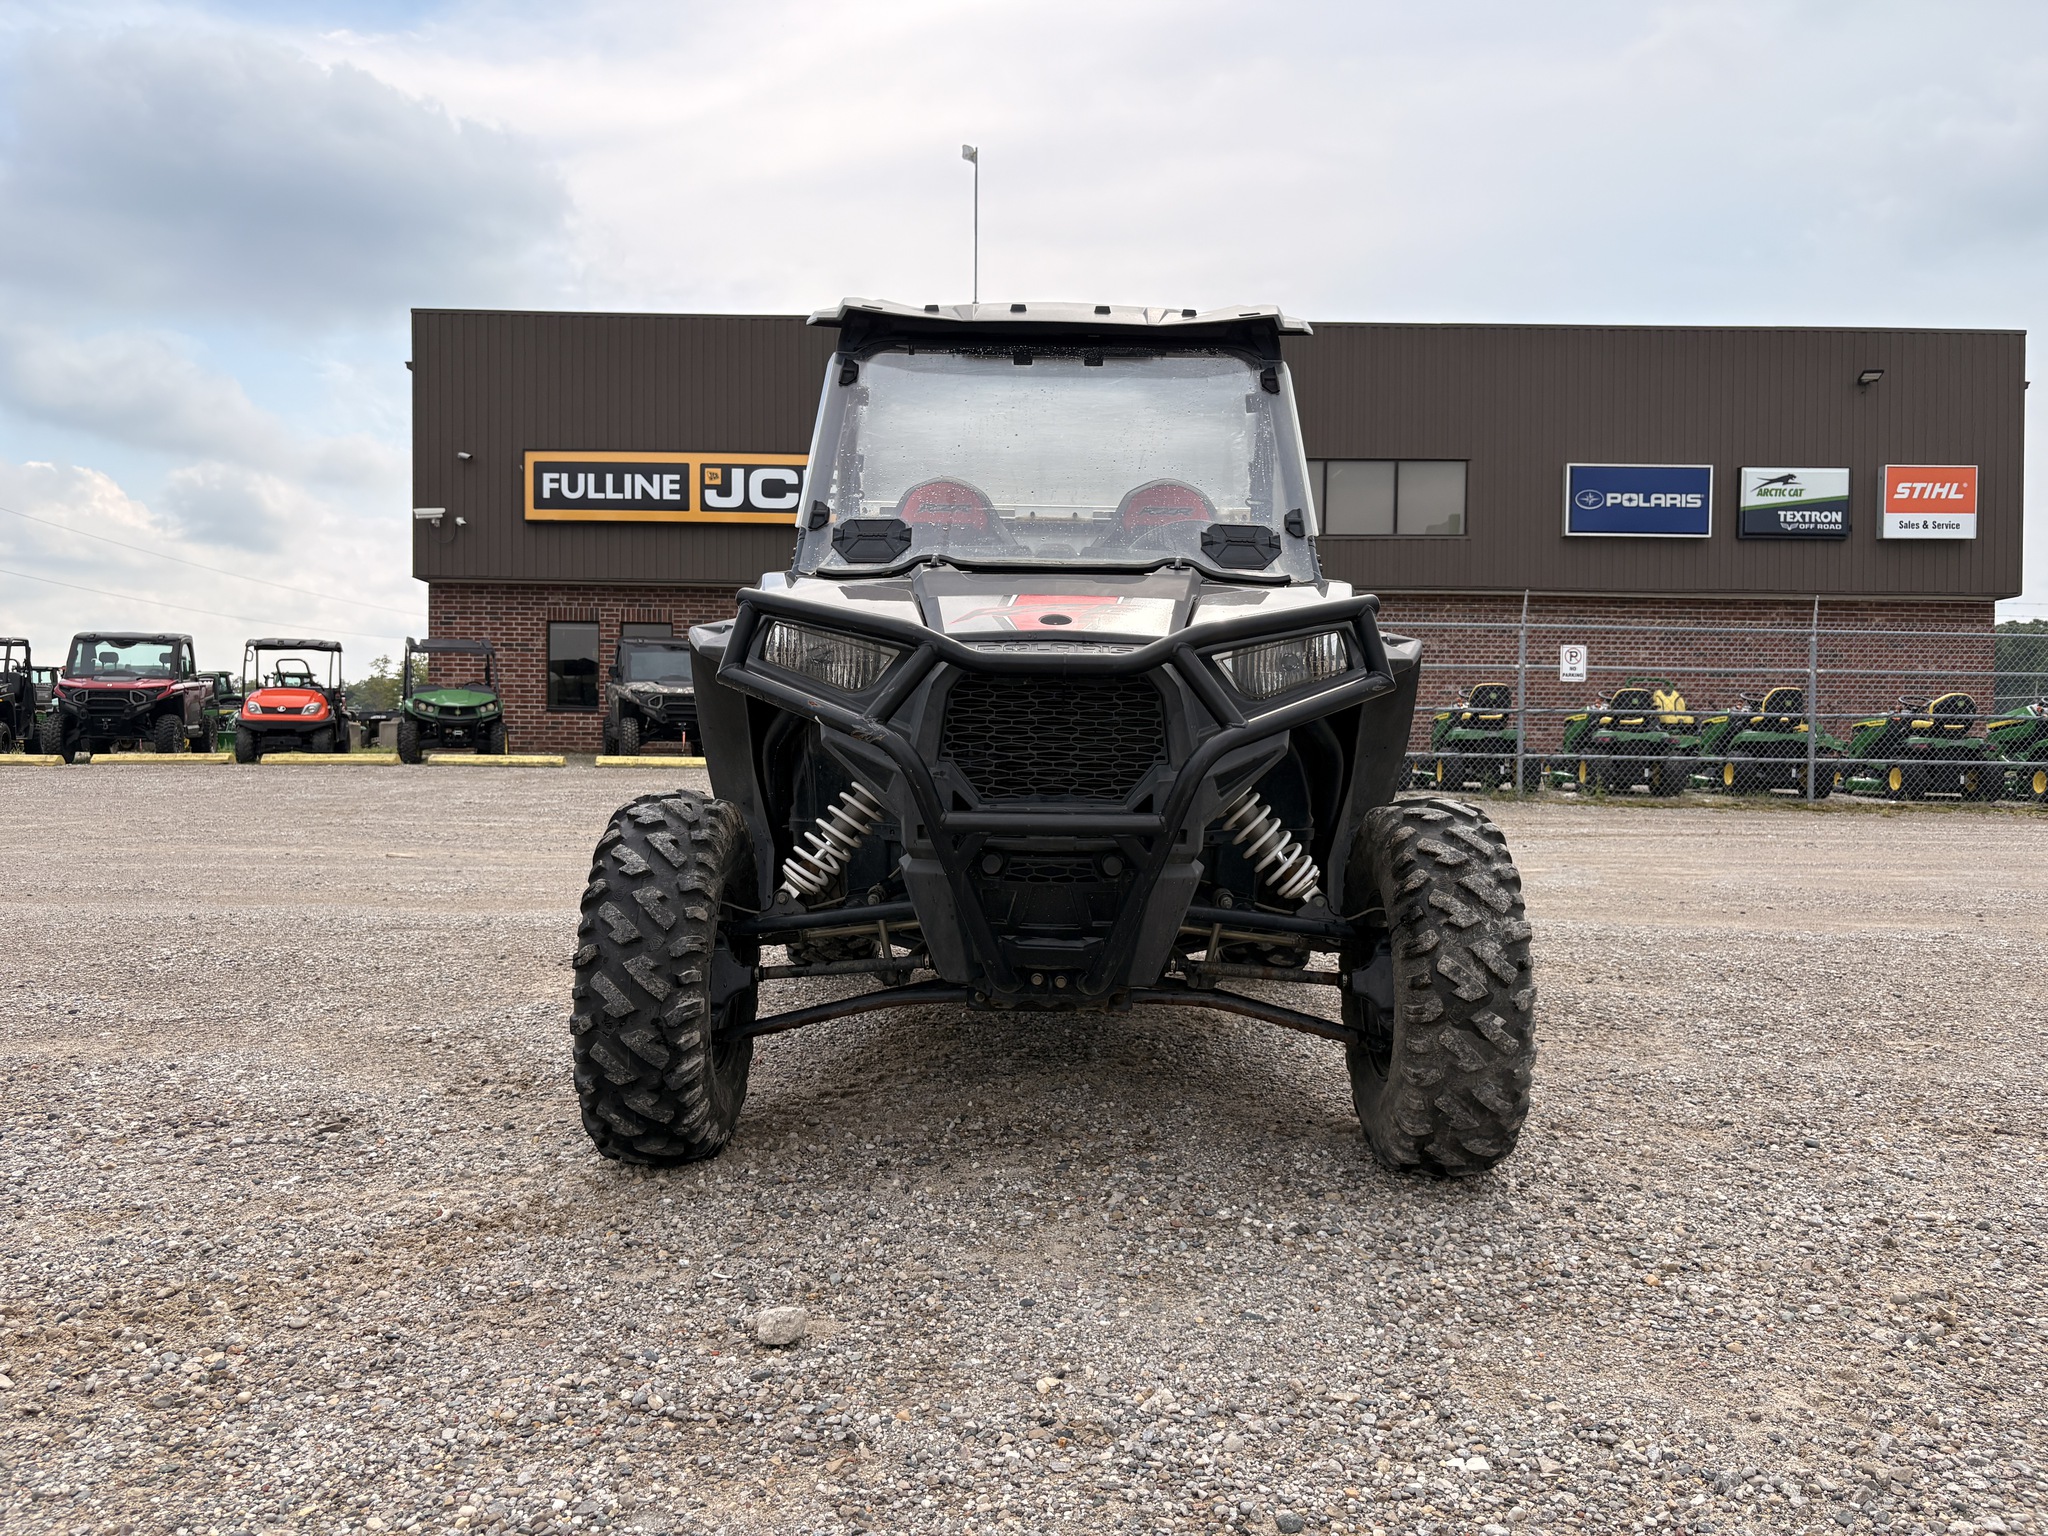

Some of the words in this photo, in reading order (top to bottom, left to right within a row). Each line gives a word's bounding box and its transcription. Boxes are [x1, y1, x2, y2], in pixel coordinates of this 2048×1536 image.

[542, 472, 681, 500] FULLINE
[704, 467, 808, 509] JC
[1756, 488, 1787, 497] ARCTIC
[1788, 488, 1804, 497] CAT
[1893, 482, 1964, 499] STIHL
[1606, 493, 1702, 508] POLARIS
[1778, 511, 1842, 523] TEXTRON
[1899, 520, 1920, 530] Sales
[1922, 520, 1929, 530] &
[1932, 520, 1961, 530] Service
